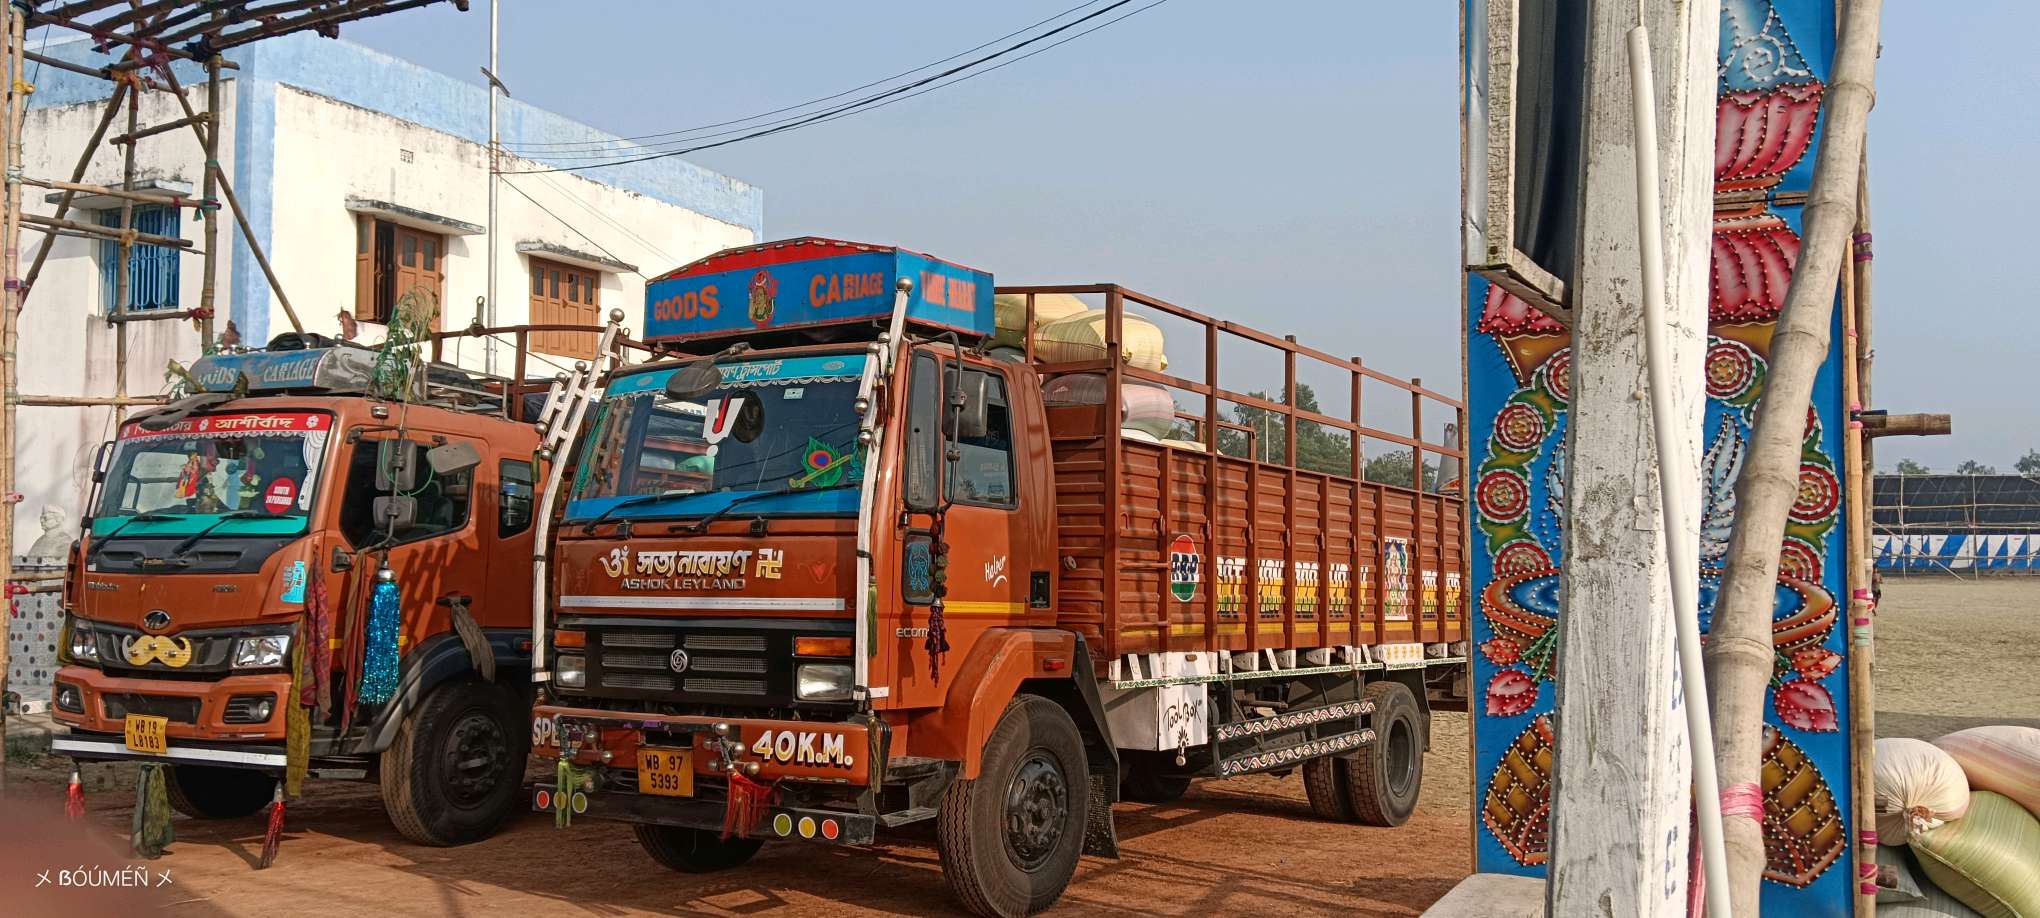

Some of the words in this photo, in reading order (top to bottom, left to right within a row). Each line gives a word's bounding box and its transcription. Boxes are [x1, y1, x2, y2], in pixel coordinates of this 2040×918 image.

[654, 284, 720, 321] GOODS
[215, 414, 294, 430] আশীর্বাদ
[621, 577, 671, 591] ASHOK
[673, 577, 746, 591] LEYLAND
[645, 754, 660, 770] WB
[669, 755, 683, 772] 97
[651, 773, 679, 790] 5393
